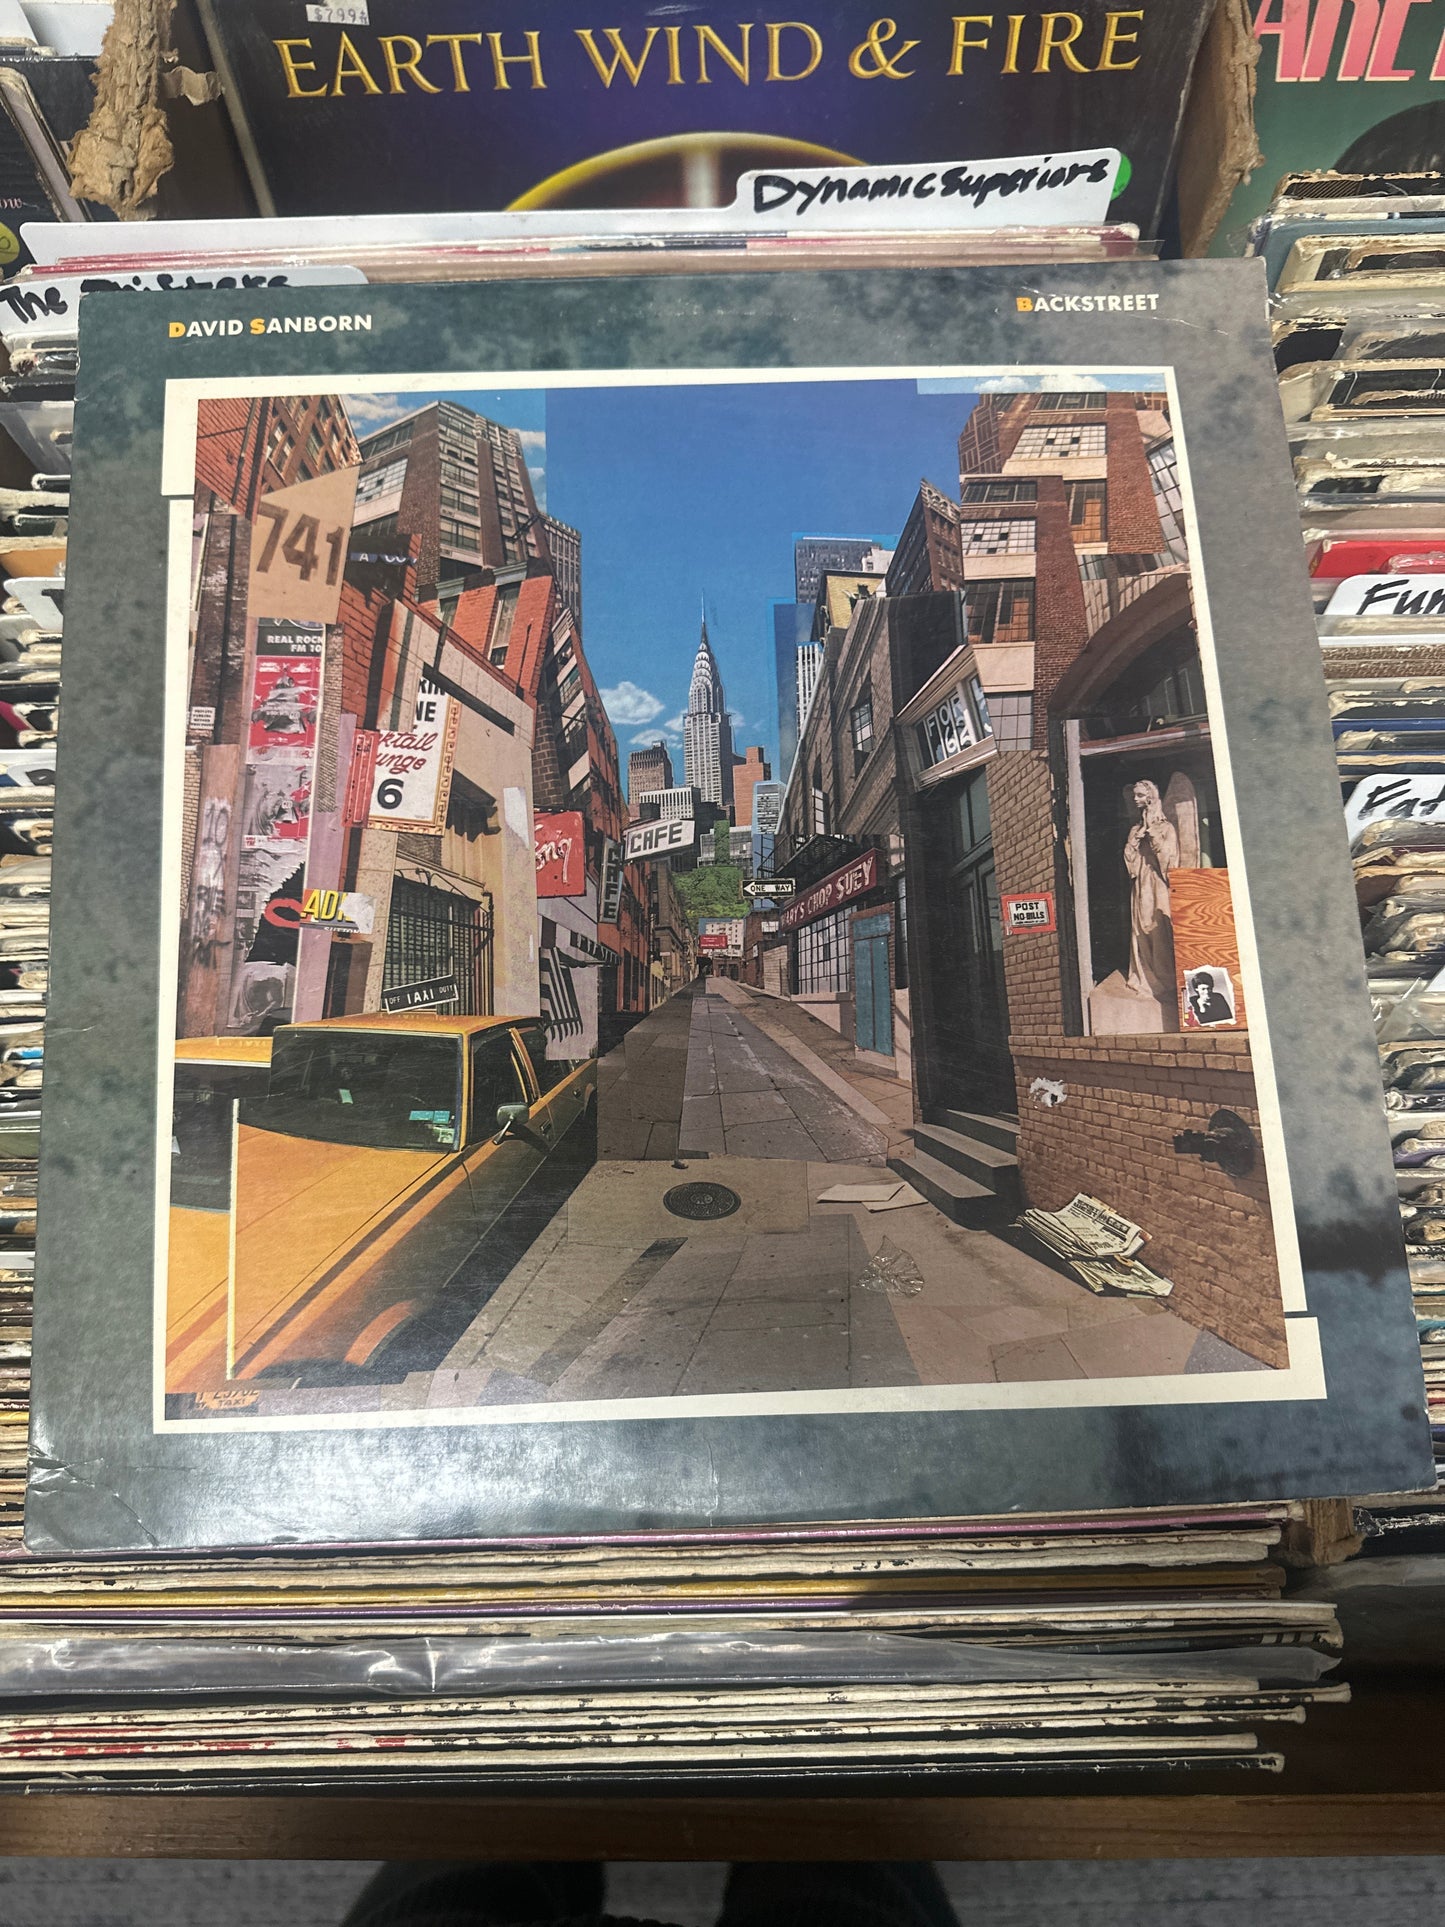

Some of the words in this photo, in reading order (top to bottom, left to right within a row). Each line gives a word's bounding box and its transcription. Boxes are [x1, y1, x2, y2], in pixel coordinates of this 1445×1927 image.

[272, 29, 547, 98] EARTH
[575, 22, 824, 89] WIND
[848, 17, 922, 79] &
[946, 9, 1145, 76] FIRE
[753, 169, 938, 216] Dynamic
[940, 155, 1110, 209] Superiors
[0, 285, 68, 324] The
[1016, 293, 1160, 313] BACKSTREET
[168, 318, 244, 338] DAVID
[250, 314, 373, 335] SANBORN
[255, 502, 346, 586] 741
[266, 635, 294, 644] REAL
[290, 644, 307, 653] FM
[377, 778, 404, 810] 6
[630, 821, 683, 854] CAFE
[603, 847, 621, 919] CAFE
[750, 884, 766, 892] ONE
[807, 883, 833, 915] CHOP
[836, 856, 874, 901] SUEY
[1015, 902, 1039, 911] POST
[1026, 911, 1045, 920] BILLS
